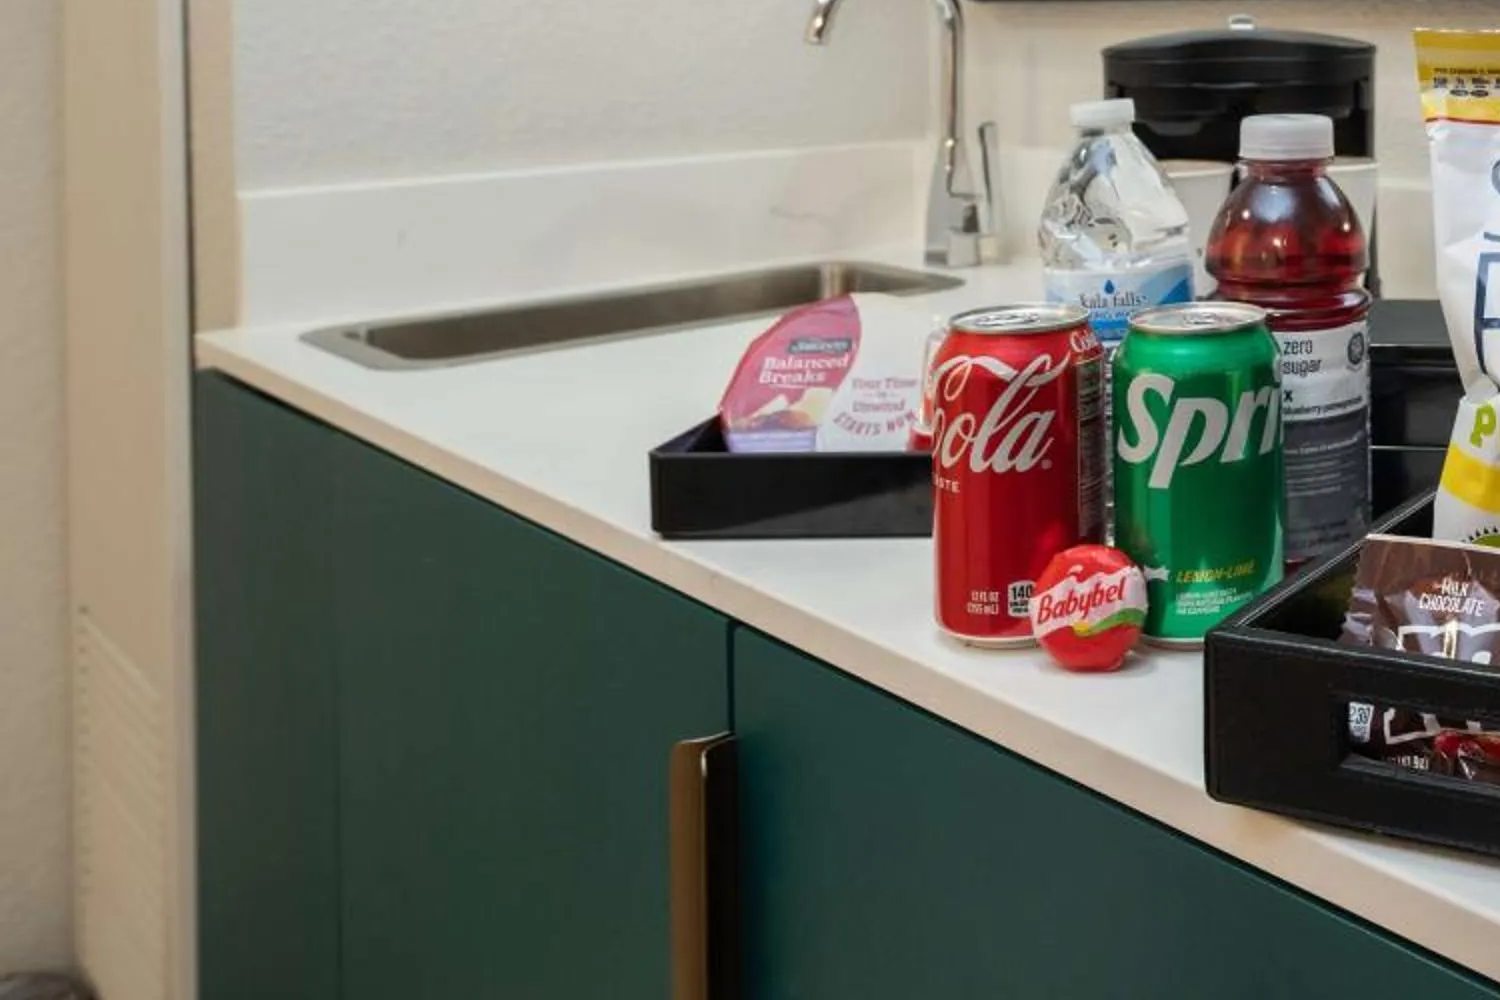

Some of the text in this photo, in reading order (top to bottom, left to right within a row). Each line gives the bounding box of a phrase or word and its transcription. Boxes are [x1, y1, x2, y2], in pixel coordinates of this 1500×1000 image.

[1283, 339, 1313, 356] zero
[763, 353, 850, 371] Balanced
[1282, 359, 1322, 378] sugar
[759, 369, 826, 385] Breaks
[1117, 373, 1284, 489] Spri
[1011, 584, 1034, 601] 140
[1441, 577, 1470, 597] MILK
[1037, 576, 1127, 625] Babybel
[1418, 593, 1485, 617] CHOCOLATE
